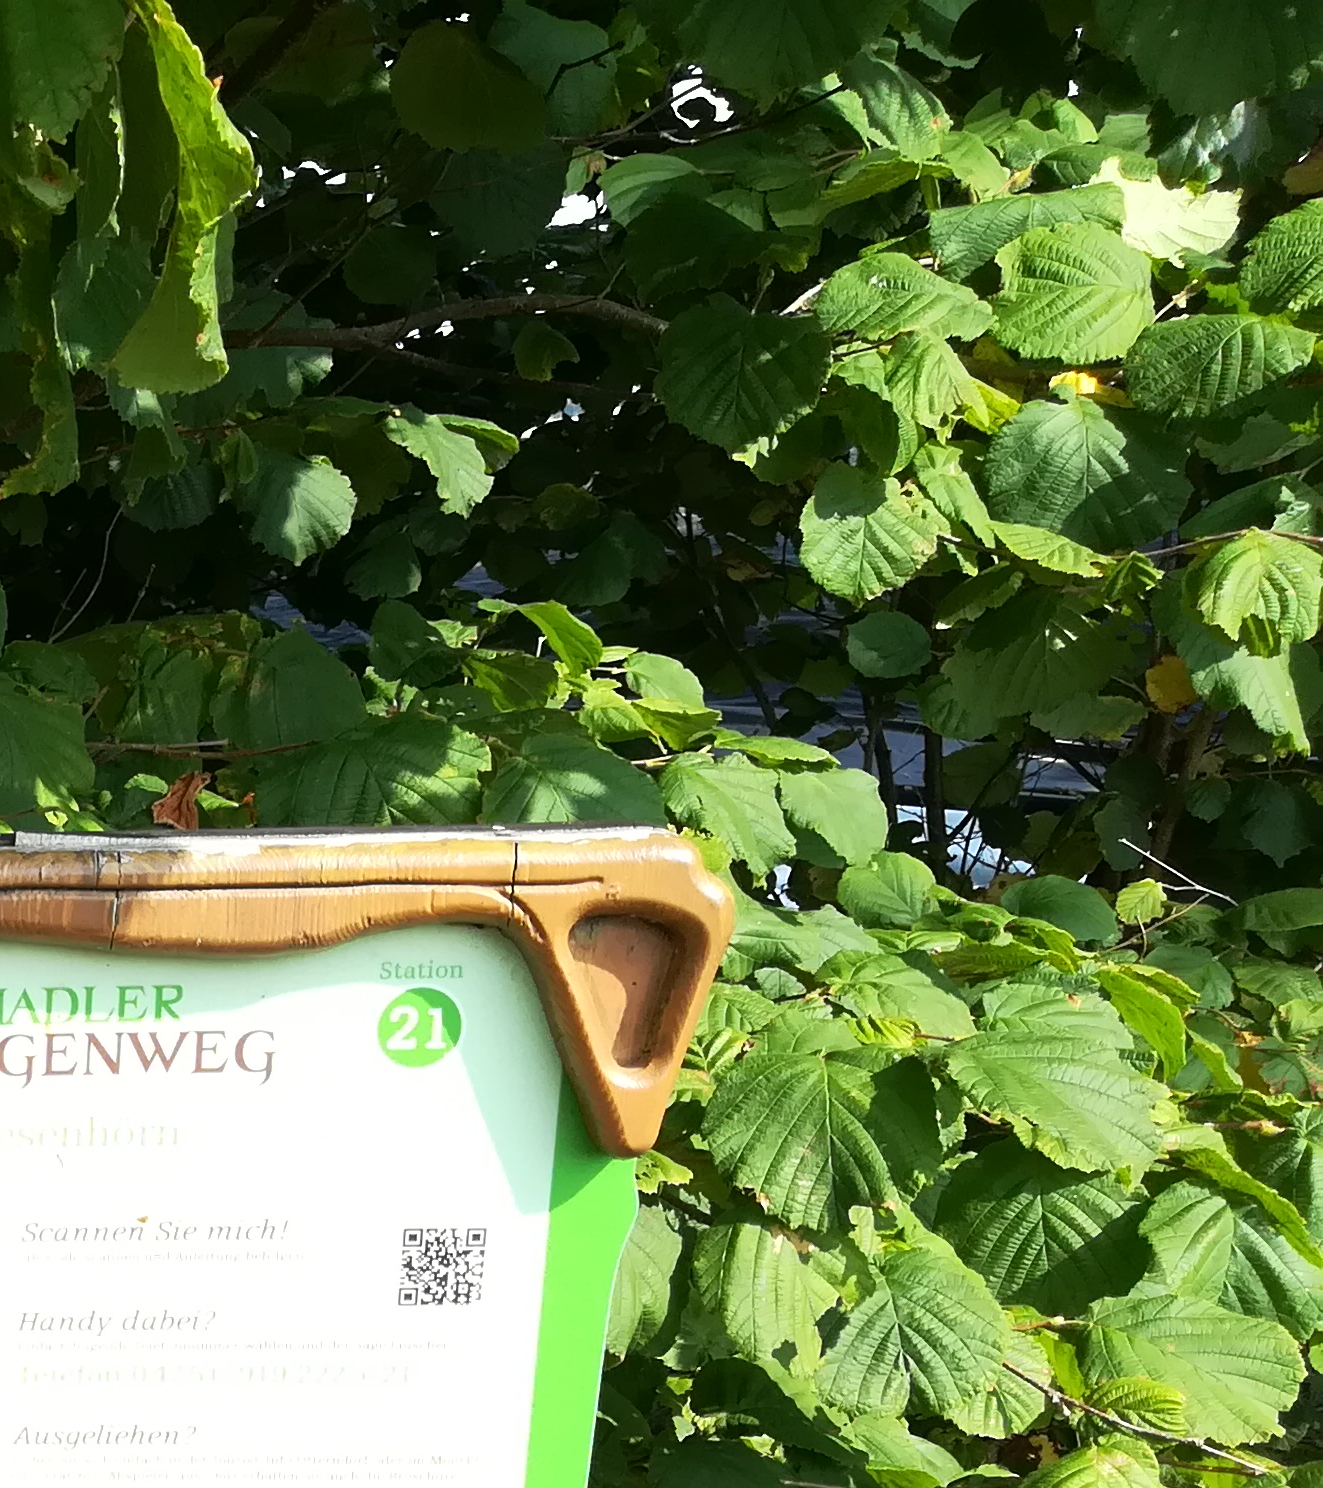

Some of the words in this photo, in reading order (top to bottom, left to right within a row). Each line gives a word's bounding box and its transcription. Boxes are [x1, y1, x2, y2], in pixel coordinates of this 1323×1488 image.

[379, 959, 465, 980] Station
[385, 1005, 448, 1052] 21
[20, 1221, 145, 1243] Scannen
[154, 1220, 198, 1242] Sie
[206, 1217, 290, 1241] mich!
[18, 1309, 114, 1337] Handy
[121, 1308, 217, 1332] dabei?
[12, 1423, 198, 1451] Ausgeliehen?
